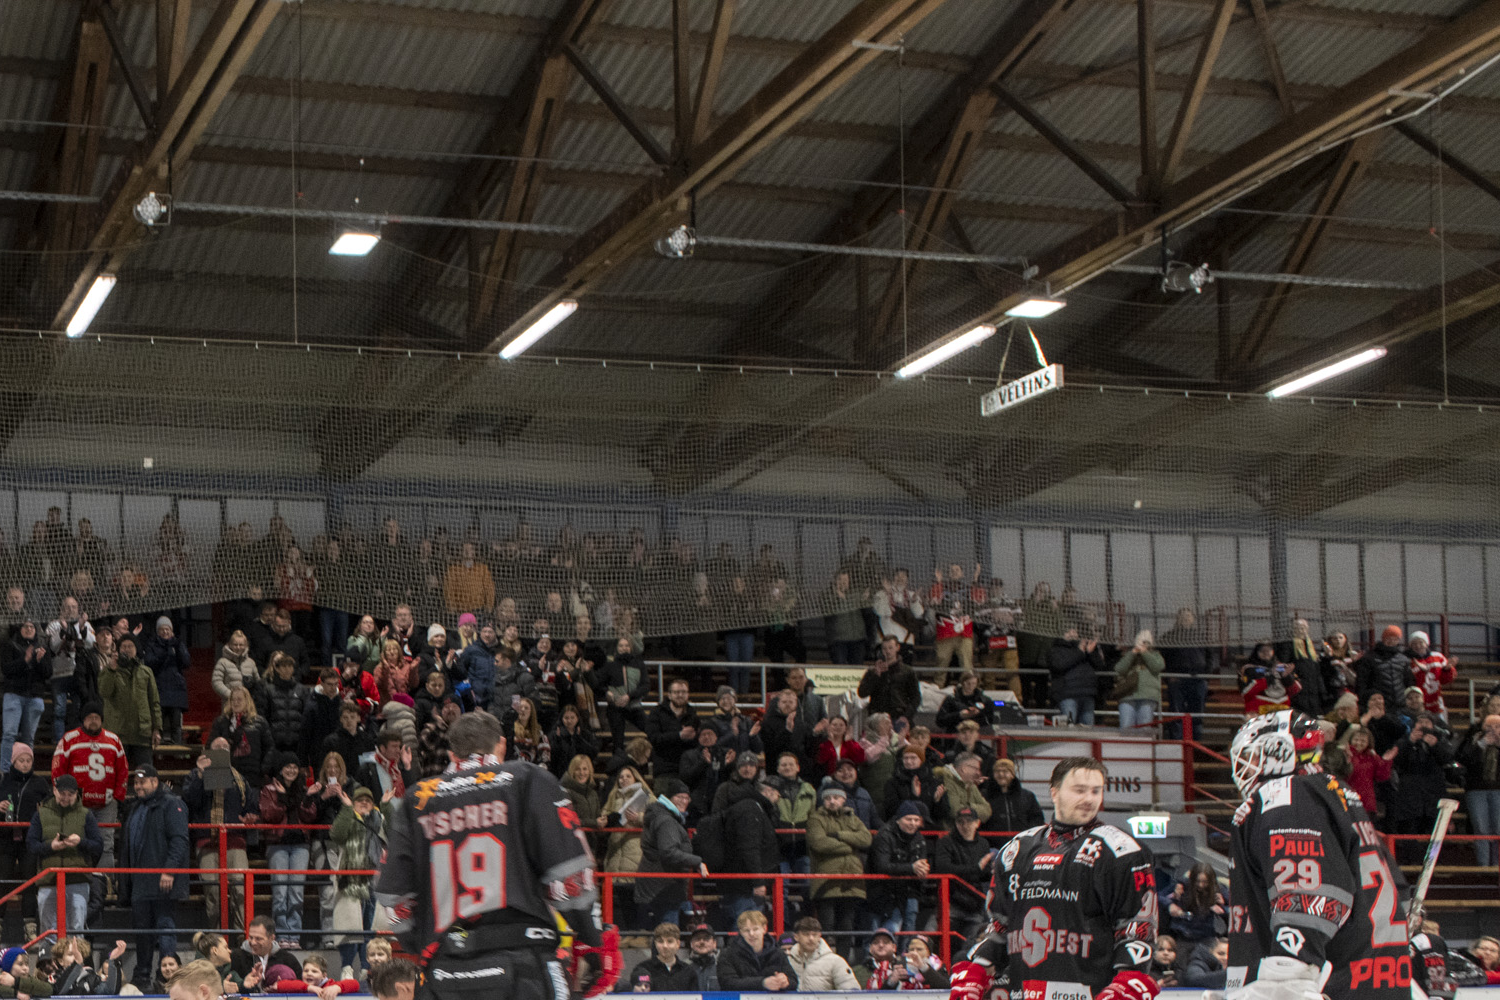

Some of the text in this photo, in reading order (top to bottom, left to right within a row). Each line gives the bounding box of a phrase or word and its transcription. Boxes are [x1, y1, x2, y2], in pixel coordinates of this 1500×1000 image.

[998, 370, 1052, 406] VELTINS
[814, 674, 862, 682] Pfandbeche
[1033, 855, 1061, 863] CCM
[429, 831, 507, 934] 19
[1273, 858, 1323, 893] 29
[1020, 887, 1079, 902] FELDMANN
